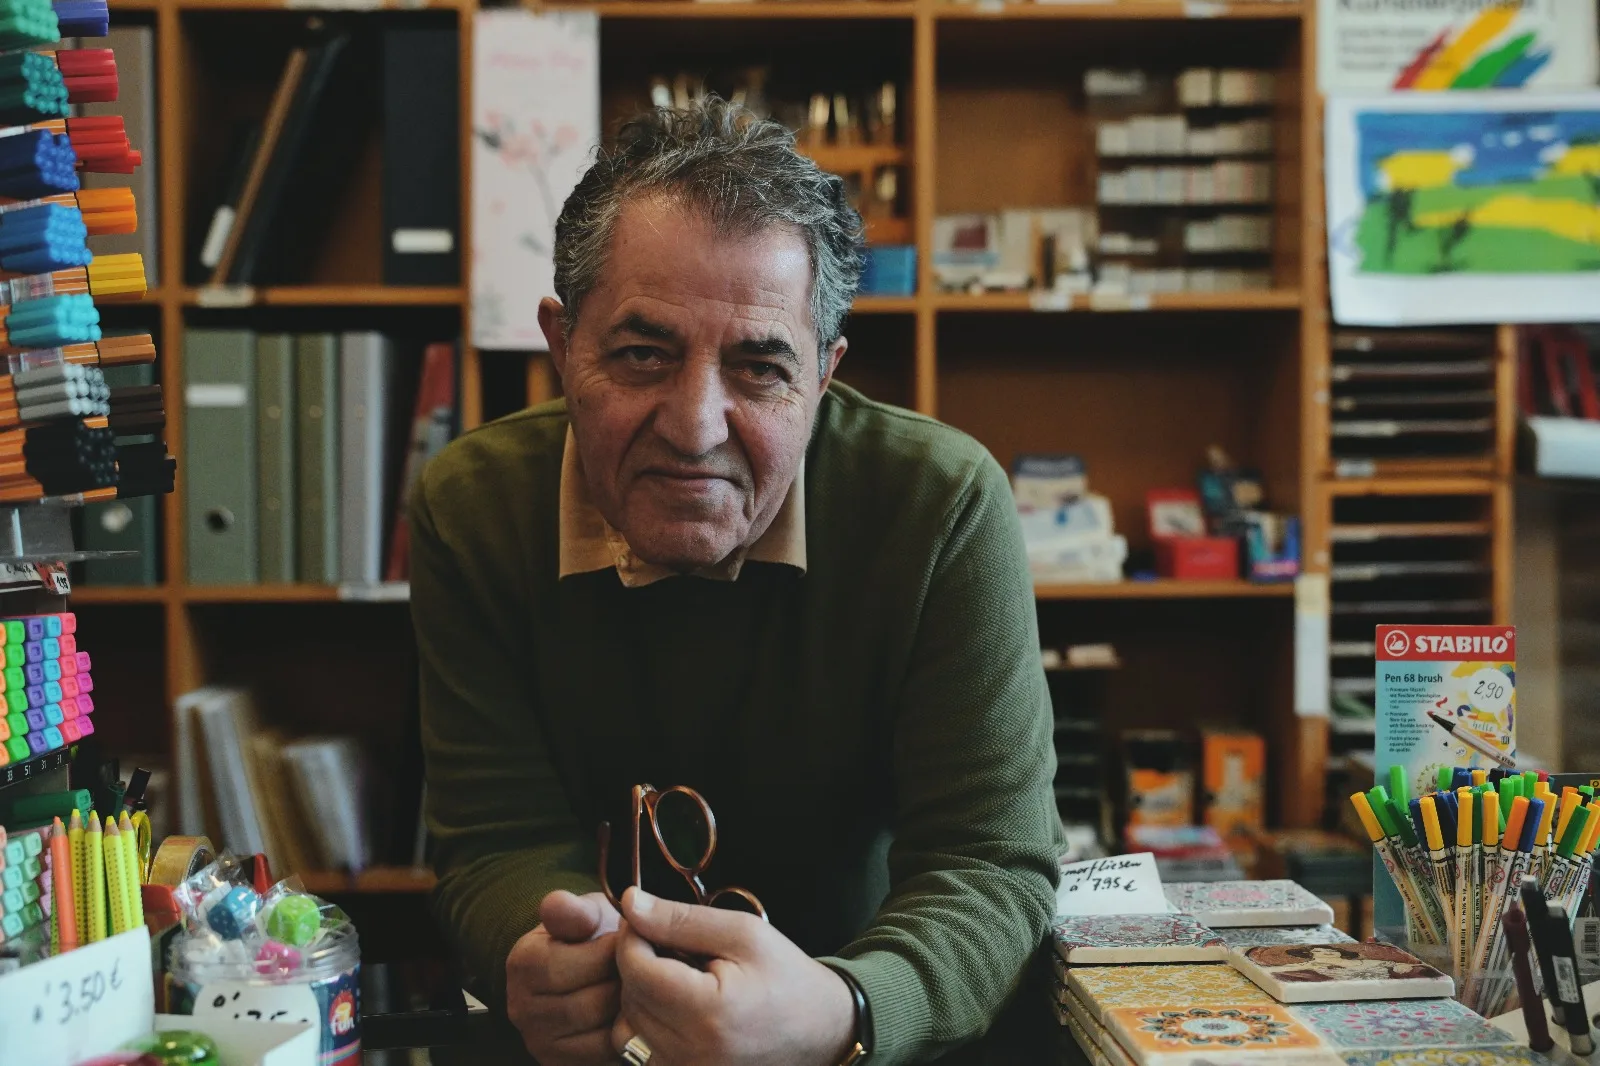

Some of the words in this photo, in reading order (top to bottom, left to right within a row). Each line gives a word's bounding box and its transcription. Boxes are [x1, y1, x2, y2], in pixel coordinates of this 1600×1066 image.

[1414, 634, 1509, 654] STABILO
[1384, 673, 1401, 683] Pen
[1403, 673, 1416, 683] 68
[1417, 673, 1443, 683] brush
[1061, 859, 1142, 881] morfliesen
